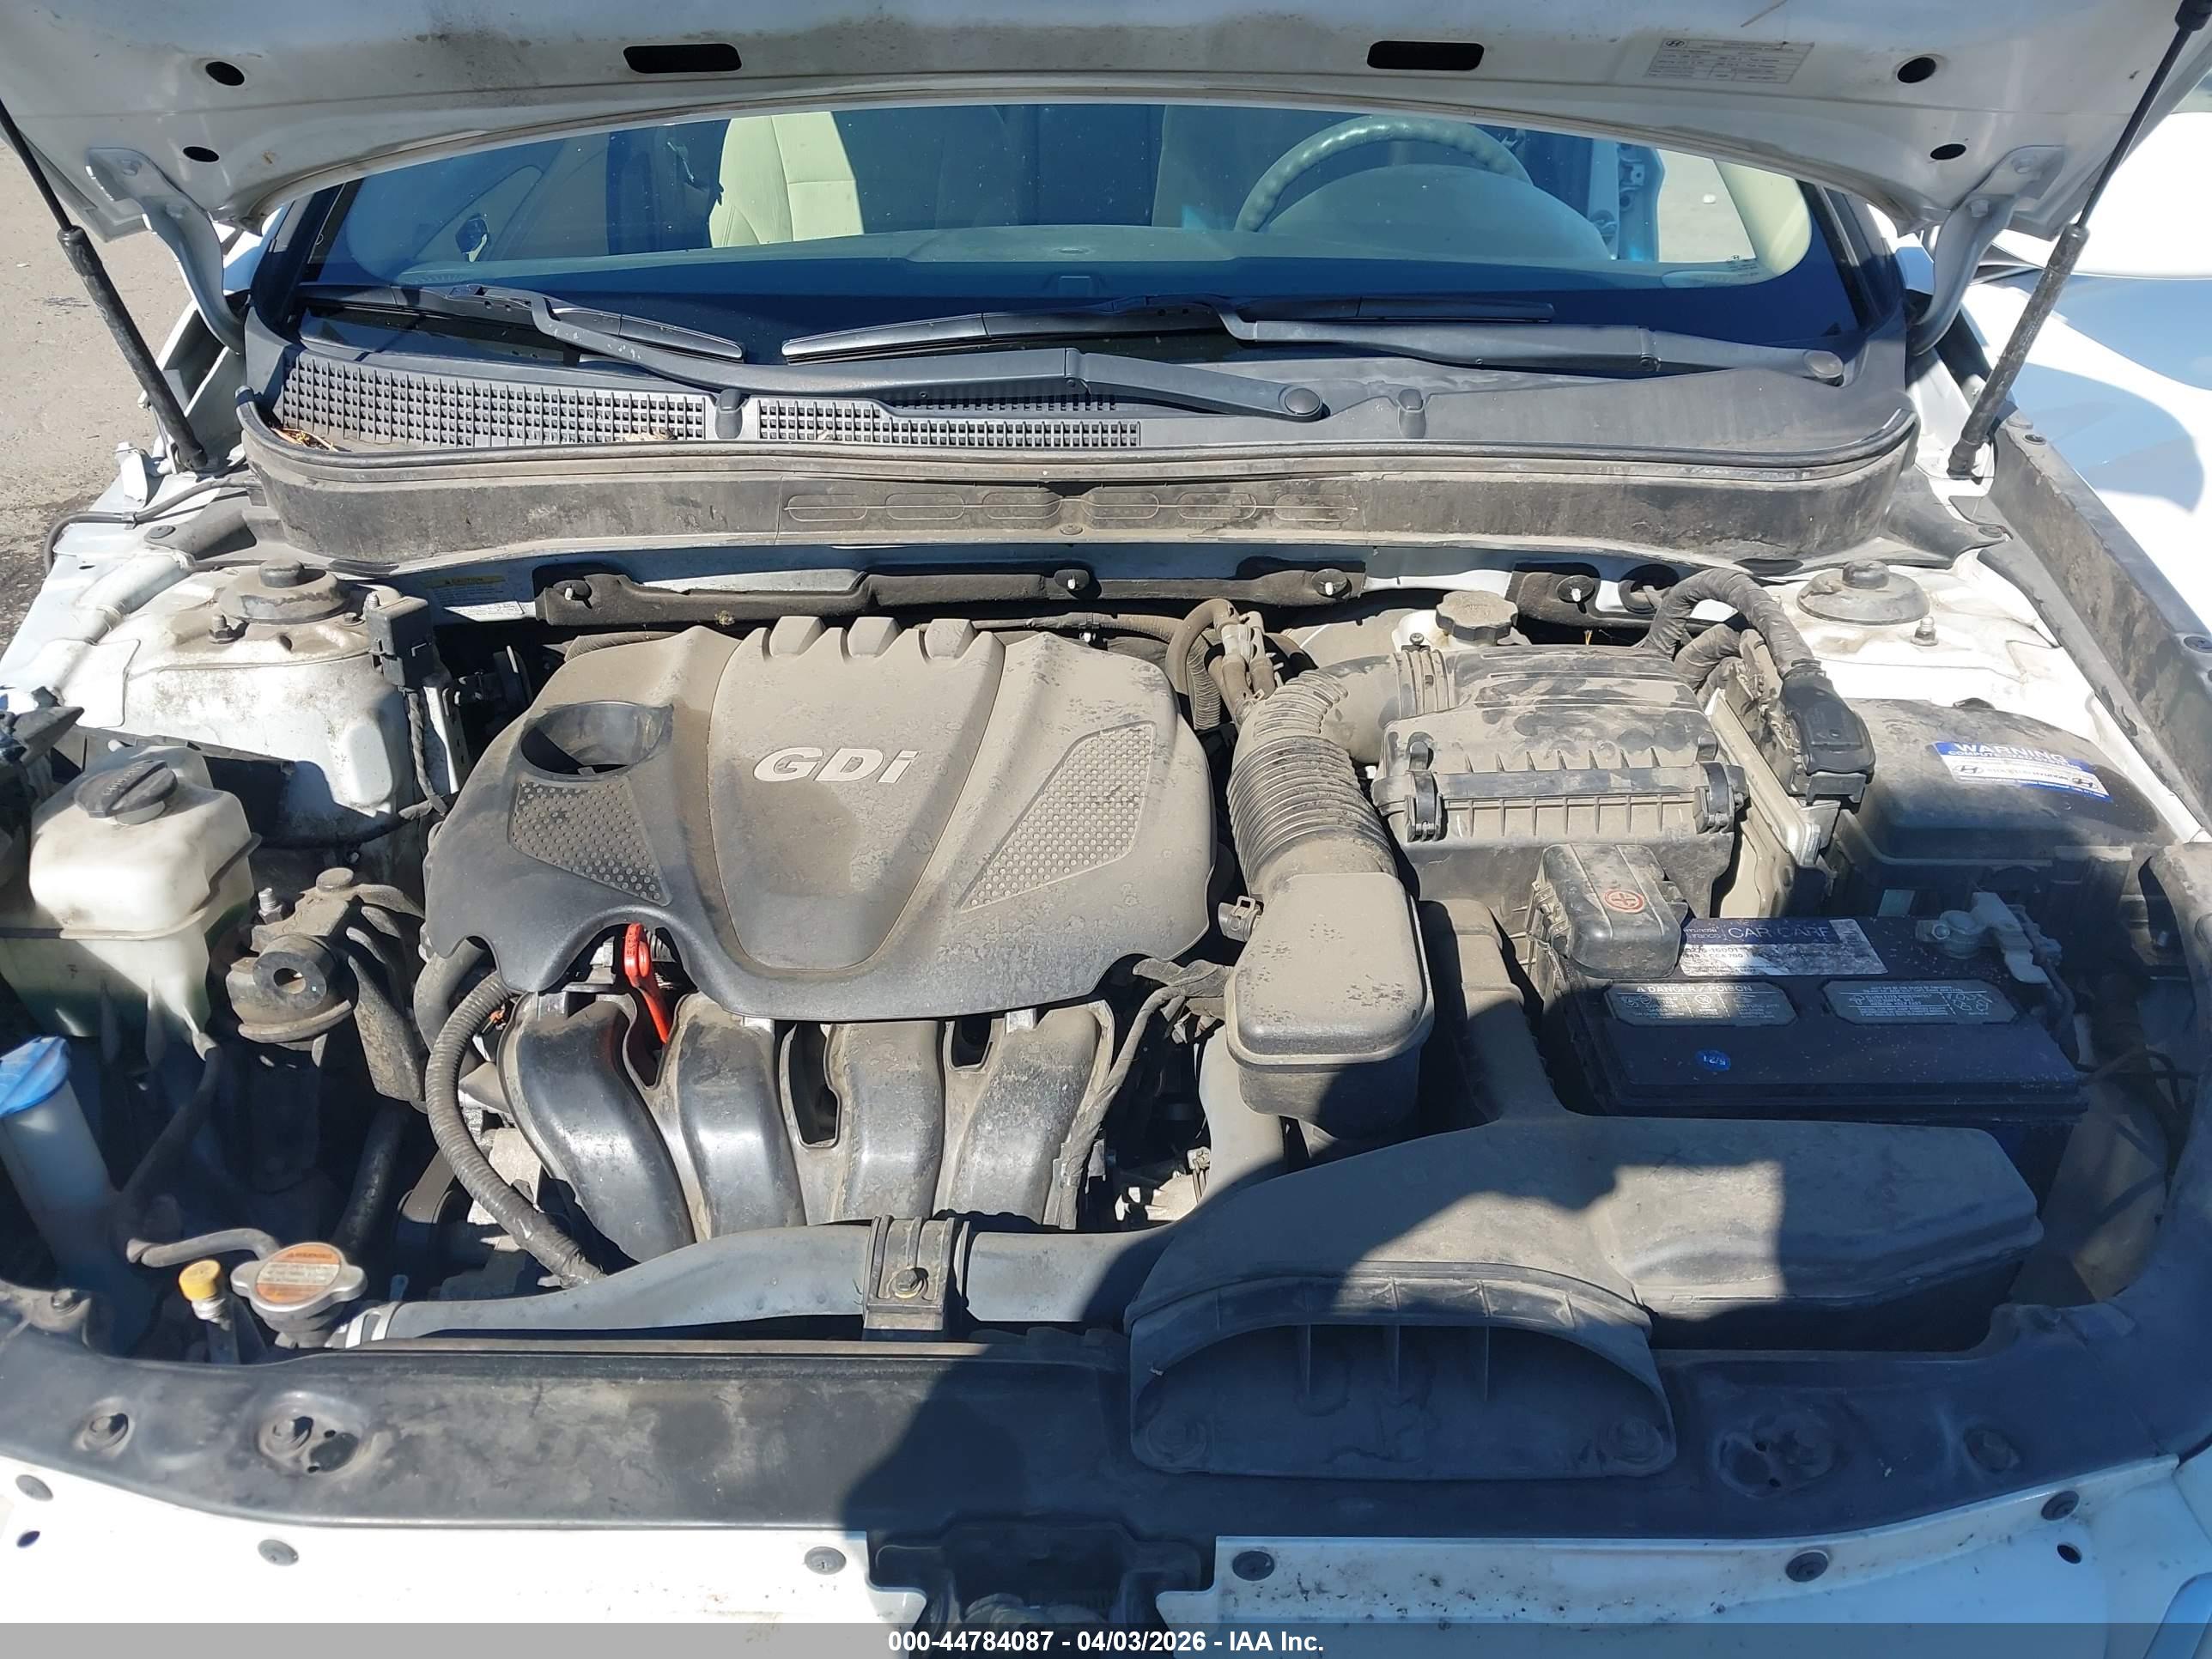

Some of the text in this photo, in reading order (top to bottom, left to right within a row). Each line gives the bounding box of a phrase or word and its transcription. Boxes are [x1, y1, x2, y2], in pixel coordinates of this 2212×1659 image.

[1954, 743, 2069, 764] WARNING
[753, 746, 921, 783] GDi
[1728, 927, 1771, 938] CAR
[1709, 984, 1753, 993] POISON
